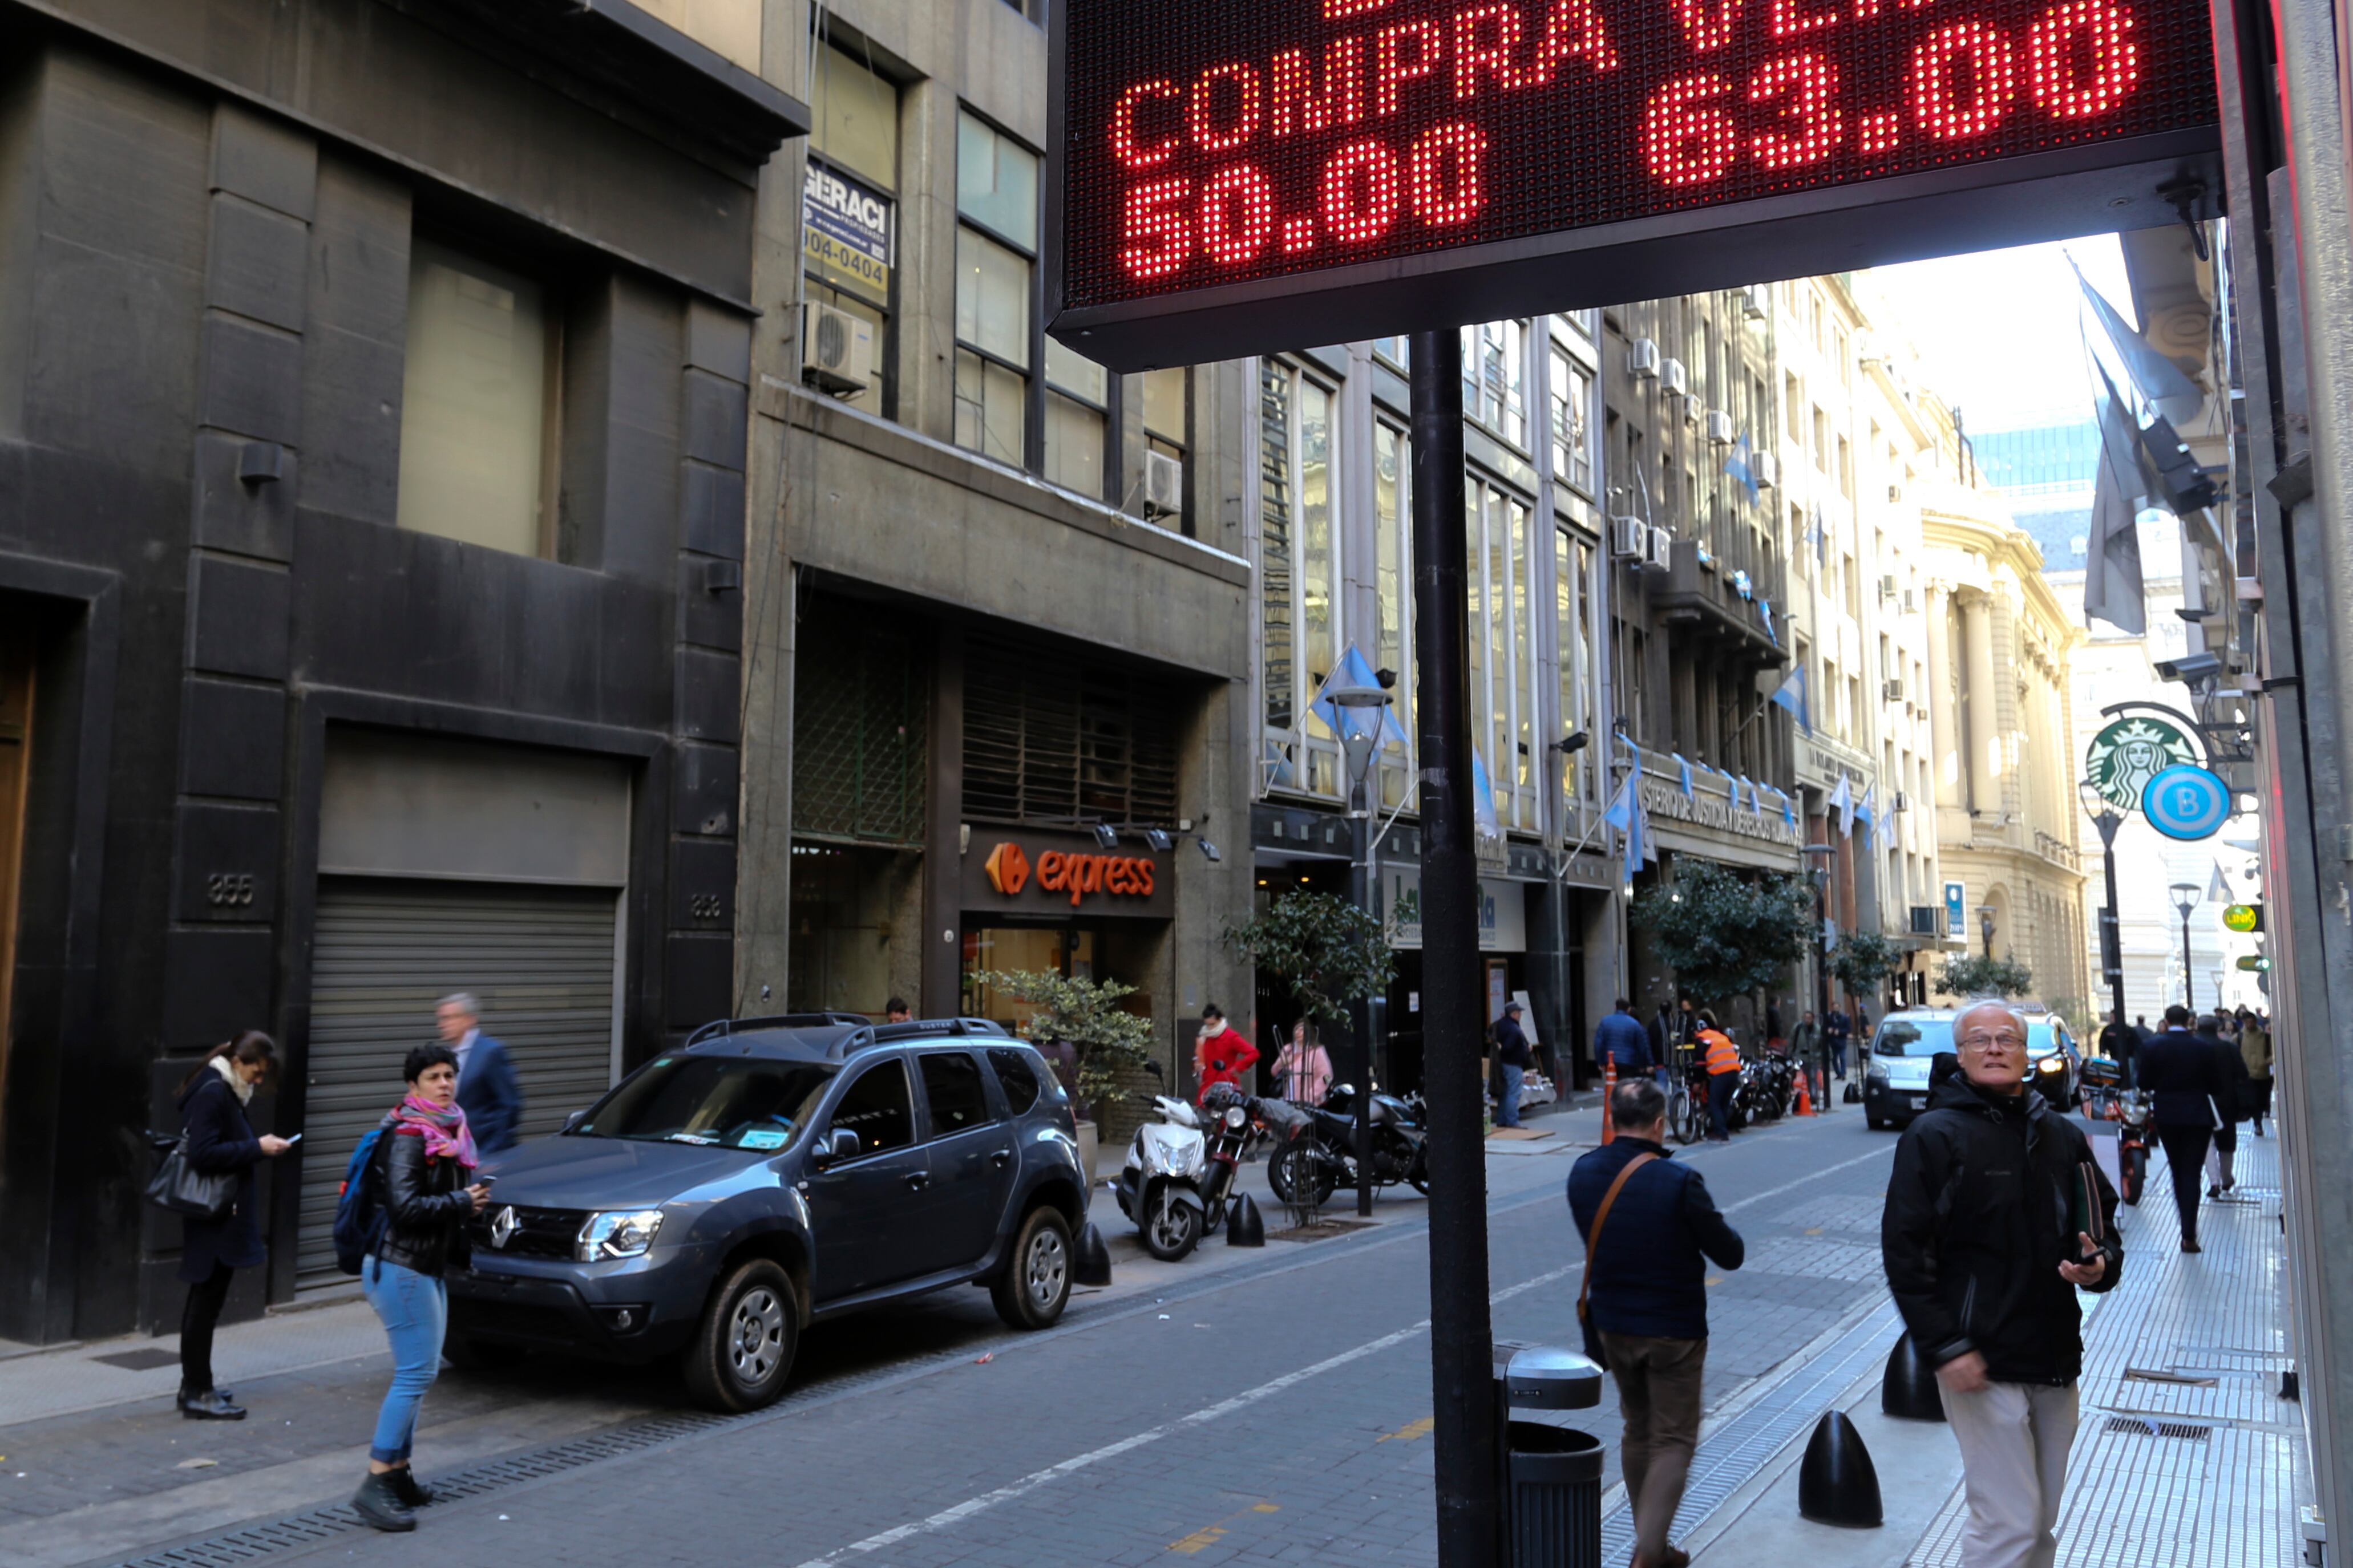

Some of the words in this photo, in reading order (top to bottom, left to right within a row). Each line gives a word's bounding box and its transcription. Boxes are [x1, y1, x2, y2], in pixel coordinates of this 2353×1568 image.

[1113, 0, 1619, 167] COMPRA
[1124, 121, 1487, 279] 50.00
[1646, 0, 2140, 185] 63.00
[2176, 788, 2200, 817] B
[207, 873, 253, 904] 355
[1036, 850, 1155, 906] express
[1949, 923, 1963, 932] 2019
[2226, 909, 2255, 924] LINK
